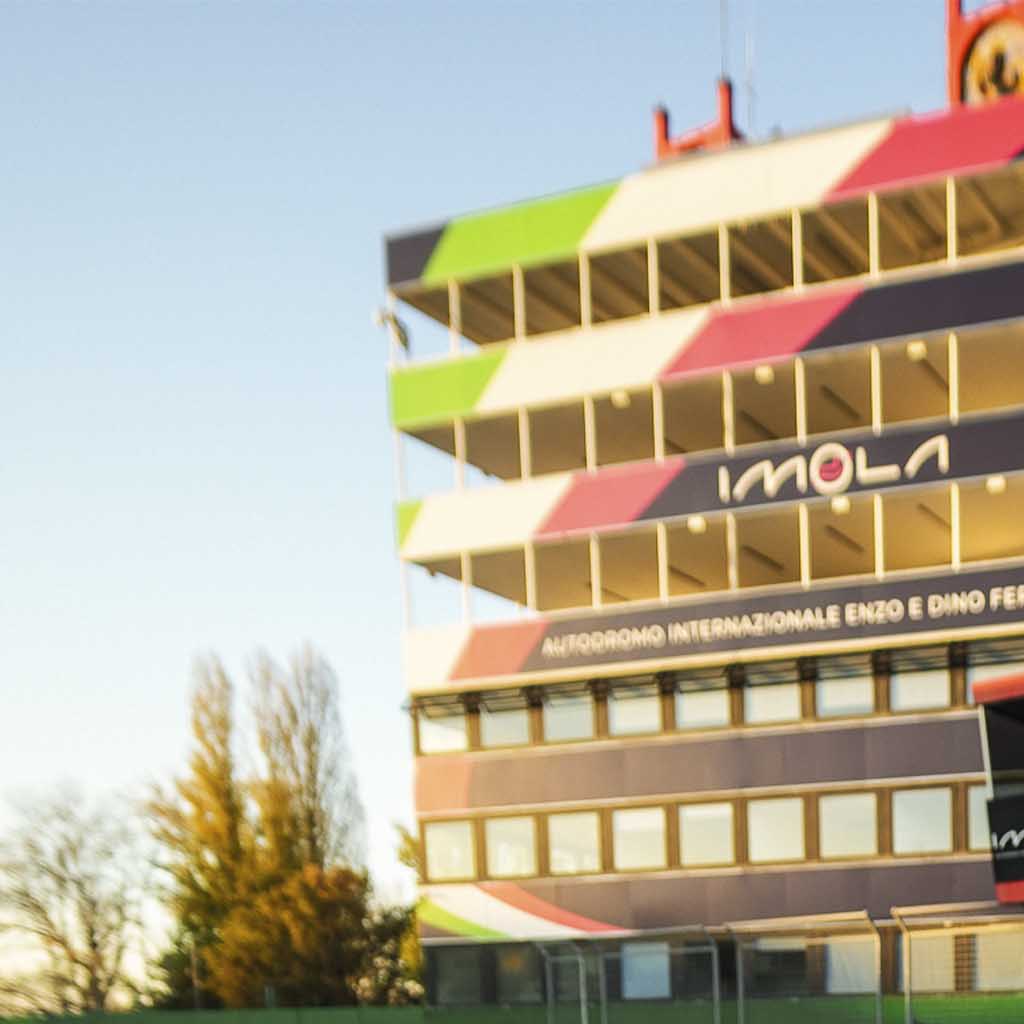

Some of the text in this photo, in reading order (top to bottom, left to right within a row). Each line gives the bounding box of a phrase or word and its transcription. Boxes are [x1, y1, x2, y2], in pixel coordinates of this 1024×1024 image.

[718, 434, 949, 503] IMOLA
[542, 624, 665, 656] AUTODROMO
[668, 604, 841, 644] INTERNAZIONALE
[845, 598, 904, 627] ENZO
[908, 596, 923, 621] E
[927, 589, 986, 619] DINO
